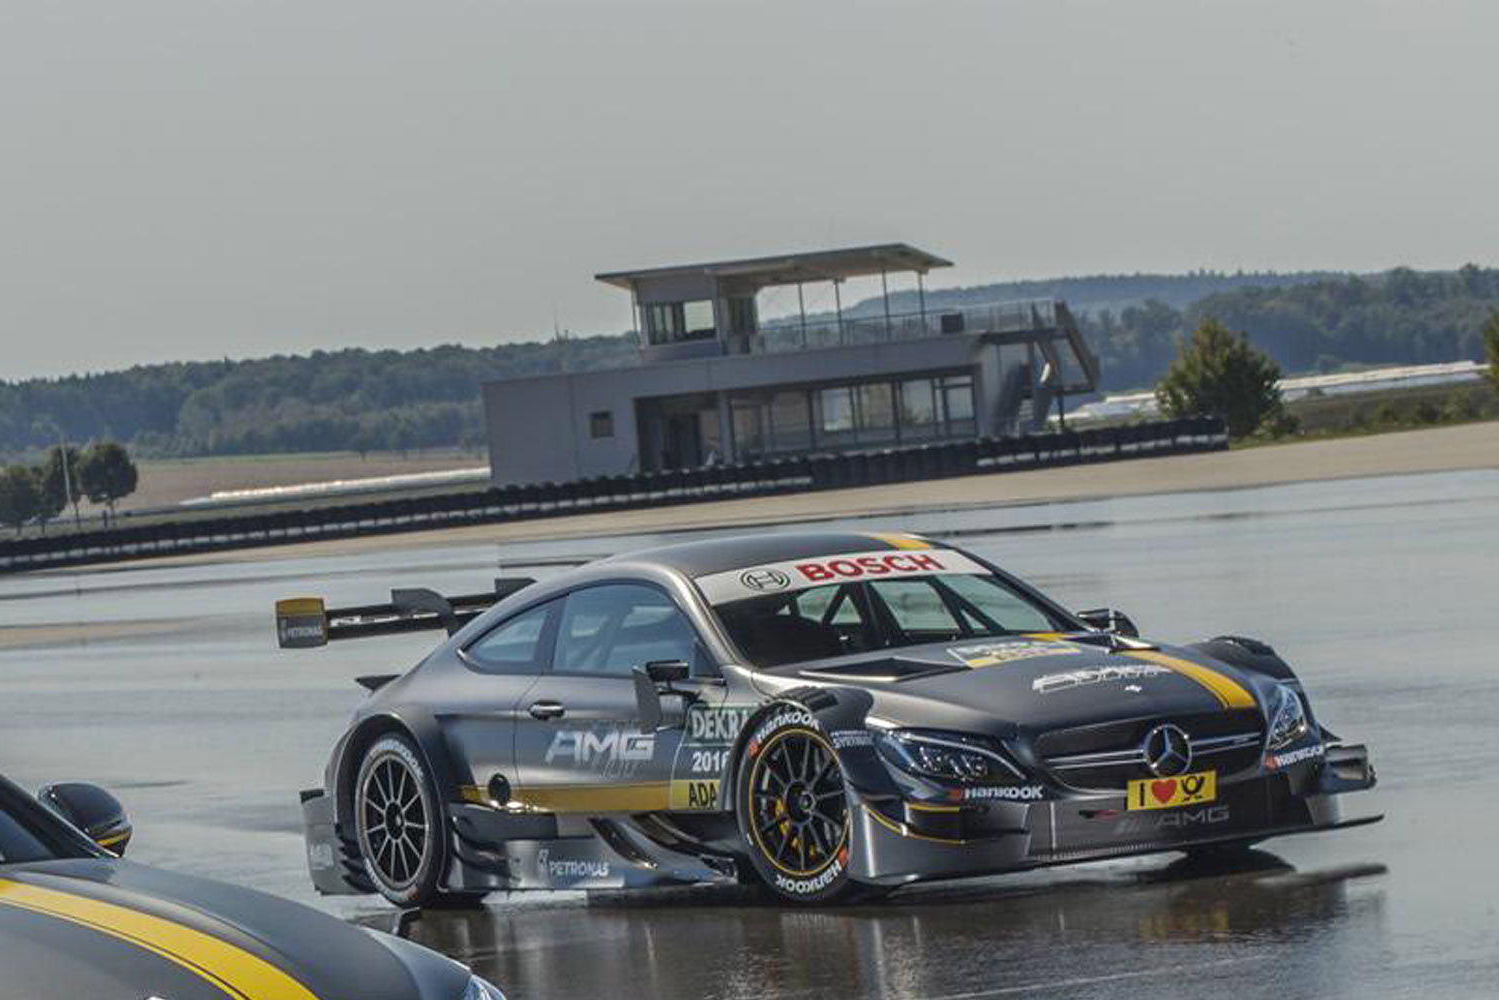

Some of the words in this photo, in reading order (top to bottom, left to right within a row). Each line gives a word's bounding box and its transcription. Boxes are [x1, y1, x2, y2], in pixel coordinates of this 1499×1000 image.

[795, 554, 947, 582] BOSCH
[546, 730, 655, 764] AMG
[1139, 783, 1145, 806] I
[1155, 804, 1230, 827] AMG
[549, 861, 610, 877] PETRONAS
